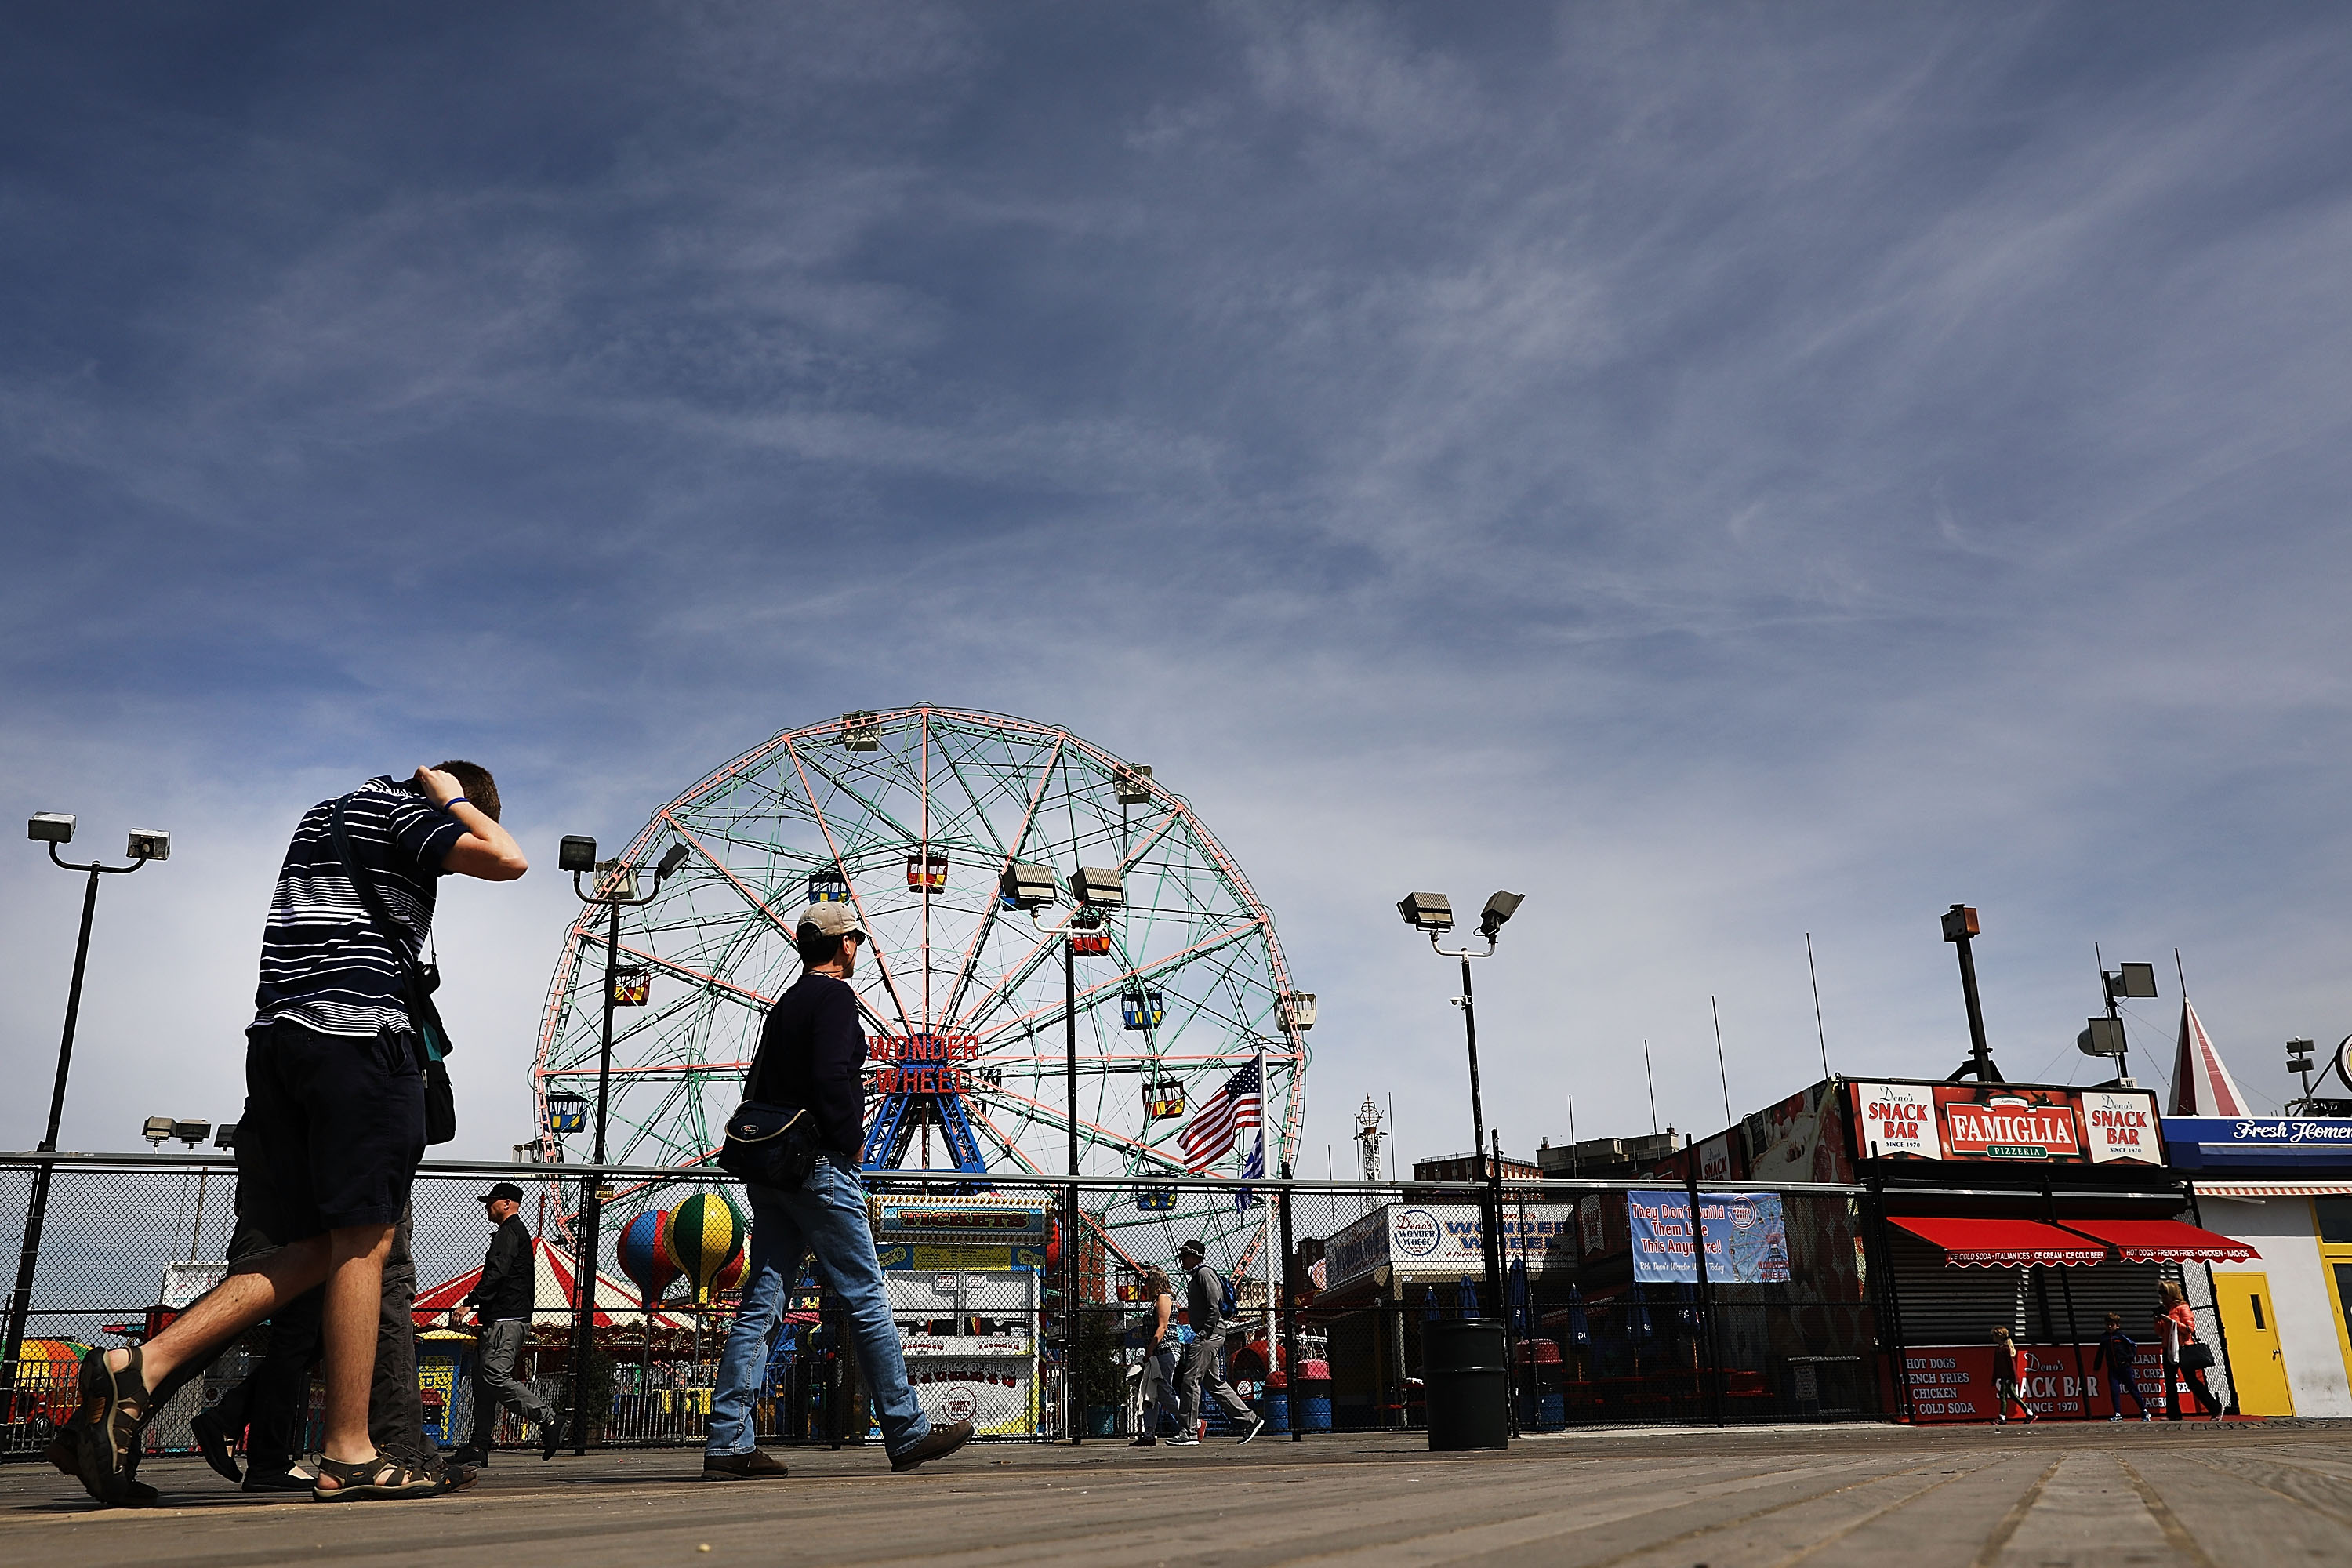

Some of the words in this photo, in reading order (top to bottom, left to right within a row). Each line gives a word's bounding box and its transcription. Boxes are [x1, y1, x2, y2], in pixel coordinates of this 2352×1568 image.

[869, 1035, 978, 1060] WONDER
[876, 1067, 971, 1093] WHEEL
[1880, 1085, 1914, 1102] Deno's
[2101, 1094, 2133, 1110] Deno's
[1868, 1102, 1929, 1121] SNACK
[2092, 1110, 2148, 1128] SNACK
[1883, 1121, 1919, 1139] BAR
[1951, 1114, 2072, 1144] FAMIGLIA
[2106, 1128, 2140, 1145] BAR
[2233, 1120, 2288, 1139] Fresh
[1994, 1147, 2040, 1156] PIZZERIA
[1704, 1156, 1728, 1178] SNACK
[900, 1210, 1028, 1229] TICKETS
[1632, 1203, 1659, 1221] They
[1662, 1204, 1692, 1220] Don't
[1395, 1215, 1433, 1229] Deno's
[1651, 1221, 1682, 1236] Them
[1685, 1221, 1708, 1236] Lie
[1460, 1237, 1562, 1250] WEEL
[1641, 1238, 1665, 1254] This
[1639, 1261, 1651, 1271] Ride
[1653, 1262, 1669, 1271] Deno's
[1670, 1262, 1691, 1271] Wonder
[1709, 1262, 1725, 1275] Today
[1906, 1359, 1926, 1369] HOT
[1929, 1358, 1956, 1369] DOGS
[2024, 1352, 2064, 1372] Deno's
[1899, 1374, 1937, 1385] ENCH
[1940, 1372, 1969, 1384] FRIES
[1913, 1388, 1958, 1399] CHICKEN
[2137, 1382, 2161, 1393] COLD
[1919, 1403, 1945, 1414] COLD
[1947, 1403, 1976, 1414] SODA
[2057, 1402, 2078, 1412] 1970
